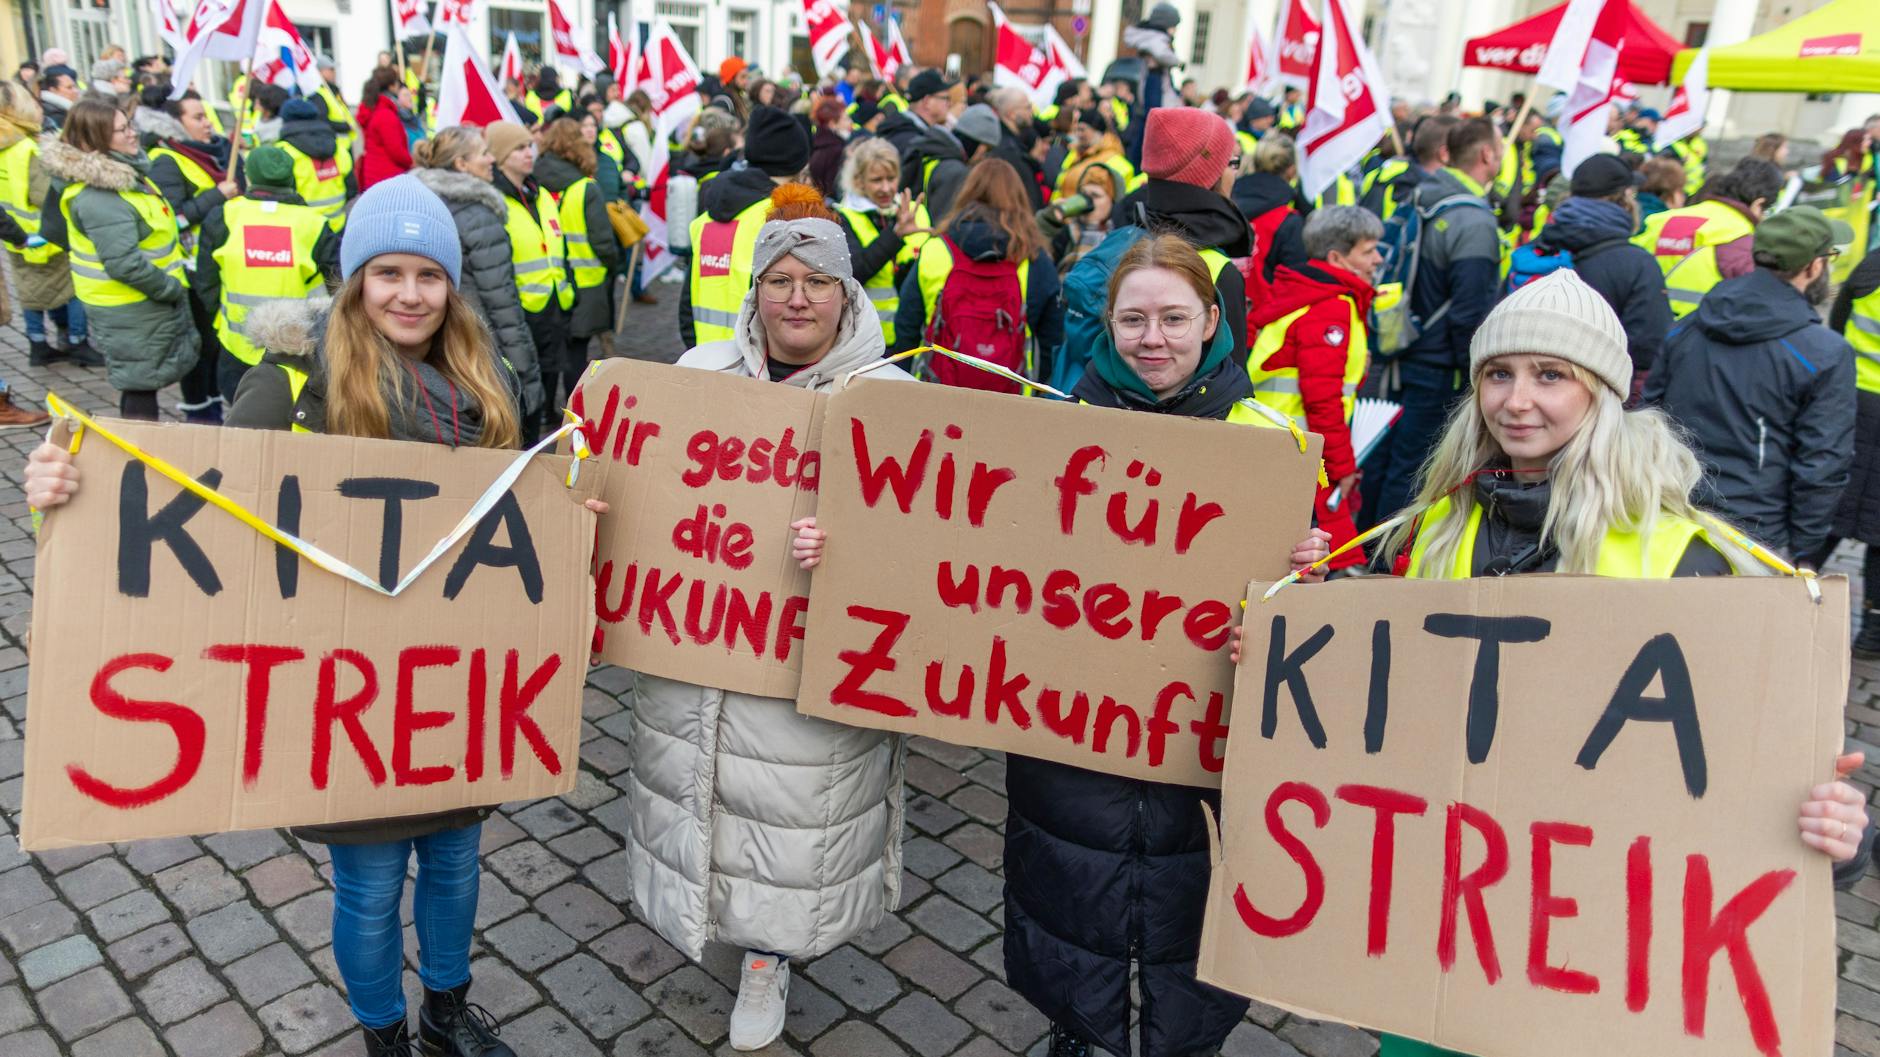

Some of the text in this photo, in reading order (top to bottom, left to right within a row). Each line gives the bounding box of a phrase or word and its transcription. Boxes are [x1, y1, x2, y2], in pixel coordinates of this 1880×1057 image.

[246, 248, 291, 263] ver.di
[701, 253, 731, 269] ver.di
[118, 459, 544, 604] KITA
[672, 503, 754, 570] die
[851, 417, 1225, 554] Wir für
[593, 558, 810, 664] UKUNF
[937, 561, 1231, 651] unsere
[64, 644, 562, 810] STREIK
[830, 605, 1228, 773] Zukunft
[1261, 613, 1707, 799] KITA
[1234, 781, 1797, 1057] STREIK
